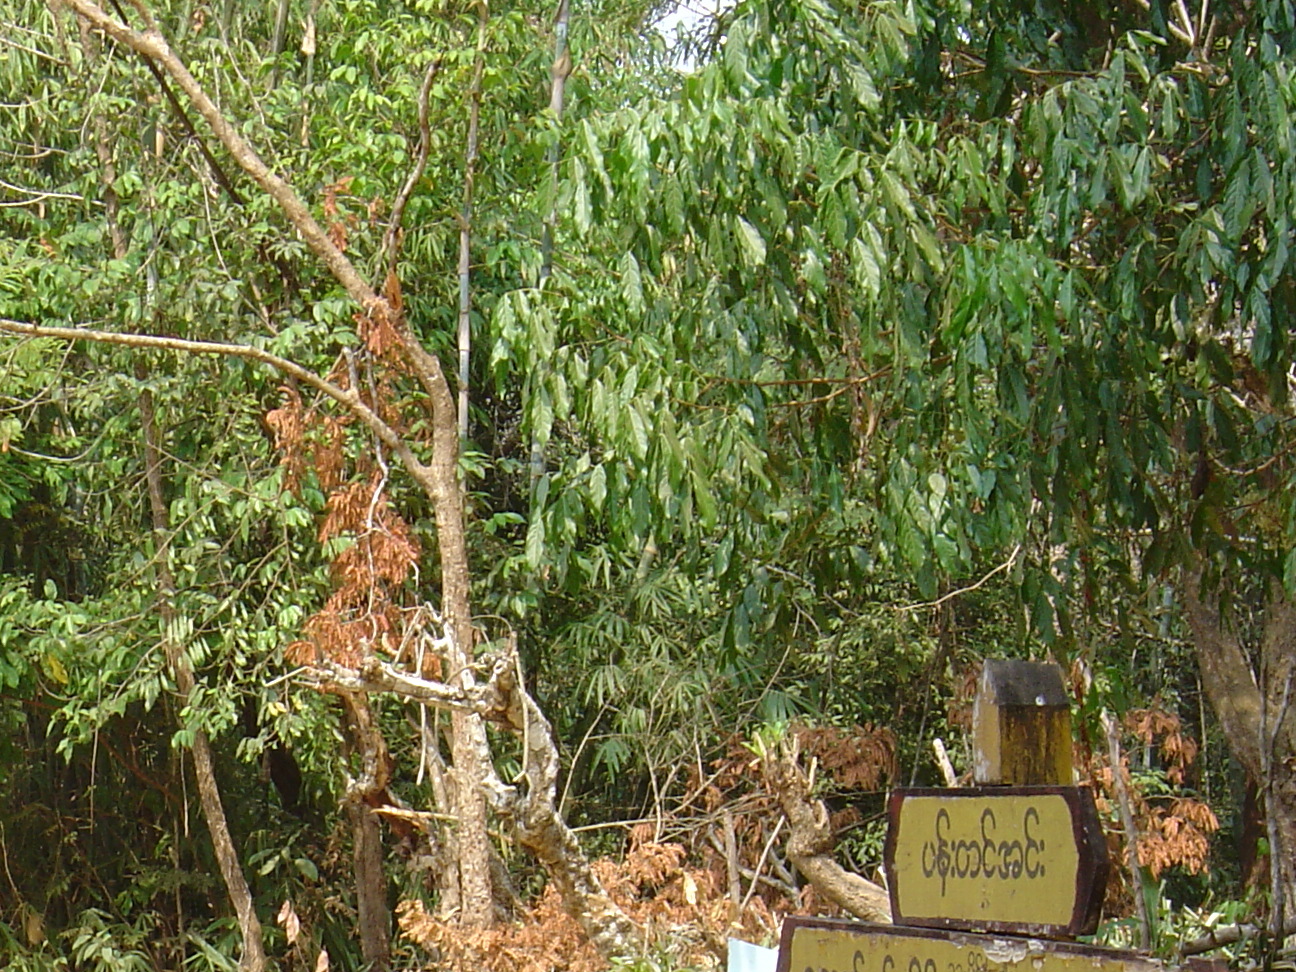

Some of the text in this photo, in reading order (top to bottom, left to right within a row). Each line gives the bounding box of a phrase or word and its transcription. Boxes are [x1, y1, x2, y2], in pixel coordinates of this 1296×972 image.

[922, 807, 1045, 897] ပန်းတင်အင်း
